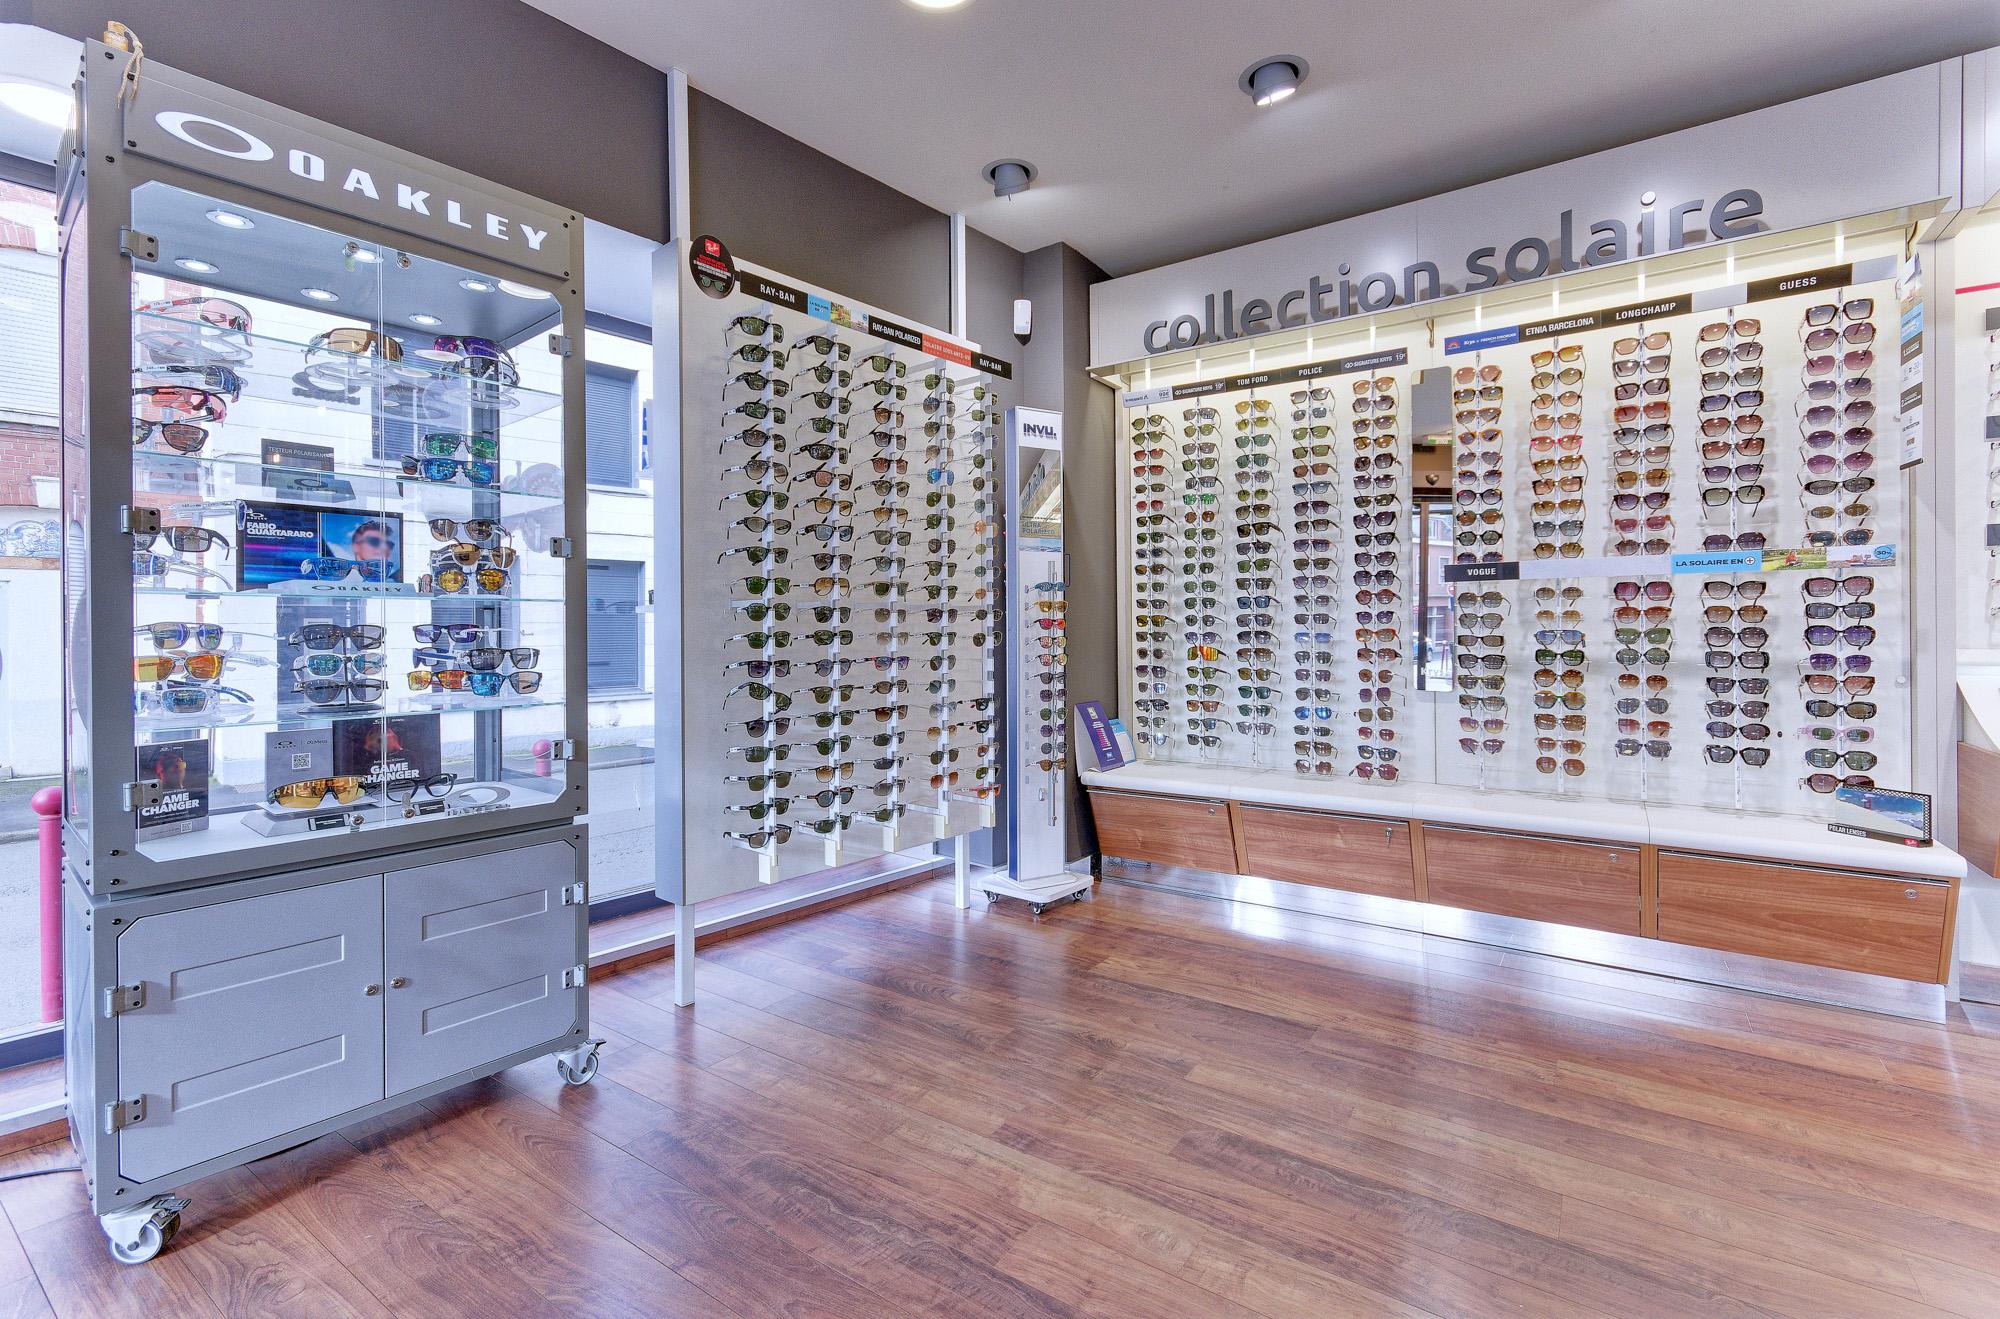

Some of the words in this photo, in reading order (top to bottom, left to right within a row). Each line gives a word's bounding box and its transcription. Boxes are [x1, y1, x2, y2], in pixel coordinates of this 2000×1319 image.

[289, 149, 548, 251] OAKLEY
[1142, 261, 1440, 355] collection
[1465, 187, 1764, 291] solaire
[1779, 276, 1817, 291] GUESS
[760, 284, 795, 303] RAY-BAN
[1616, 302, 1677, 320] LONGCHAMP
[872, 322, 895, 336] RAY-BAN
[895, 329, 921, 345] POLARIZED
[1525, 326, 1548, 336] ETNIA
[1548, 317, 1594, 332] BARCELONA
[979, 358, 1002, 371] RAY-BAN
[1298, 366, 1323, 377] POLICE
[1236, 378, 1250, 386] TOM
[1251, 375, 1268, 384] FORD
[246, 521, 277, 530] FABIO
[246, 529, 314, 538] QUARTARARO
[1467, 567, 1497, 576] VOGUE
[370, 762, 409, 774] GAME
[364, 769, 420, 784] HANGER
[162, 792, 190, 805] AME
[142, 799, 200, 816] CHANGER
[1828, 824, 1846, 833] POLAR
[1846, 828, 1867, 837] LENSES
